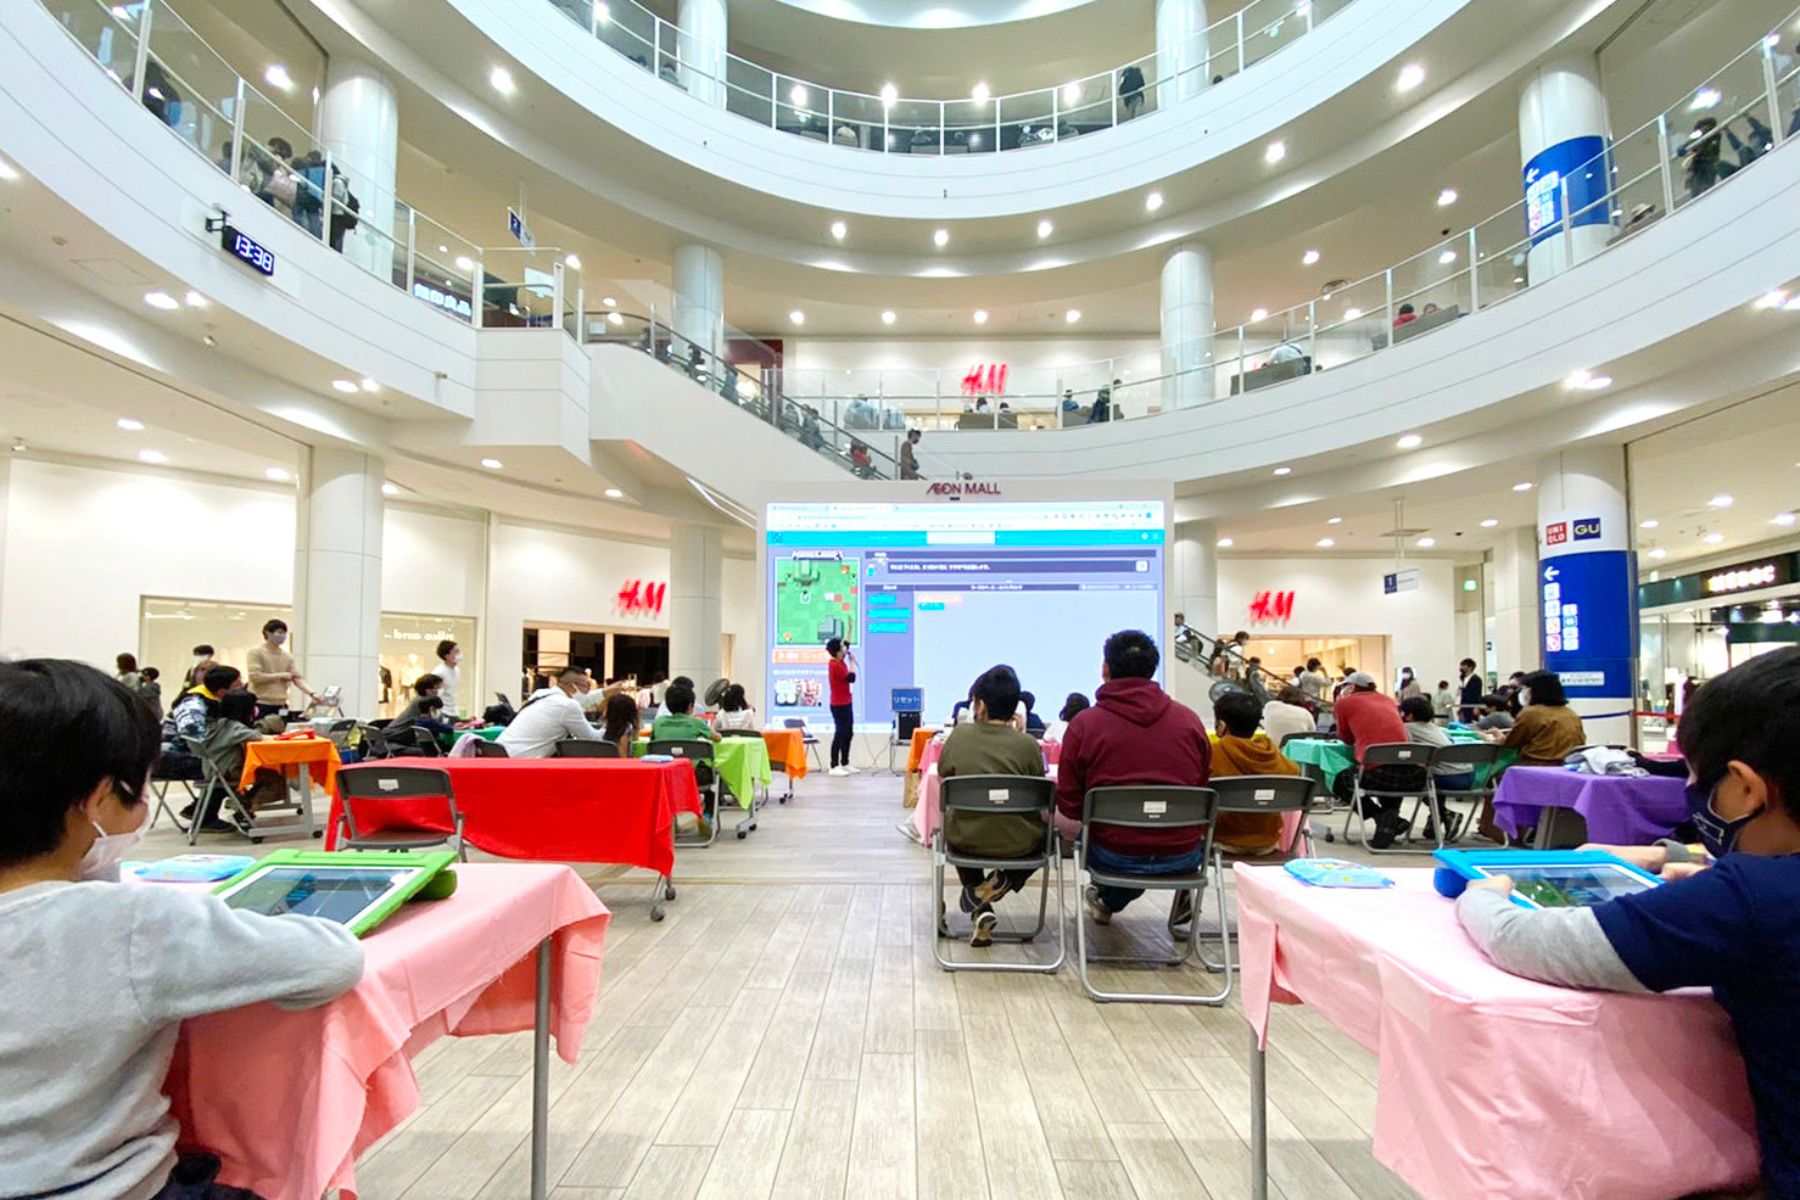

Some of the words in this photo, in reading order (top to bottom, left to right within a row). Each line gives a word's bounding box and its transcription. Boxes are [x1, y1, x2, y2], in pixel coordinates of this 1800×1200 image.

[235, 234, 273, 271] 13:38
[961, 364, 1007, 396] H&M
[965, 482, 1001, 495] MALL
[1574, 523, 1599, 536] GU
[618, 579, 666, 614] H&M
[1250, 590, 1294, 621] H&M
